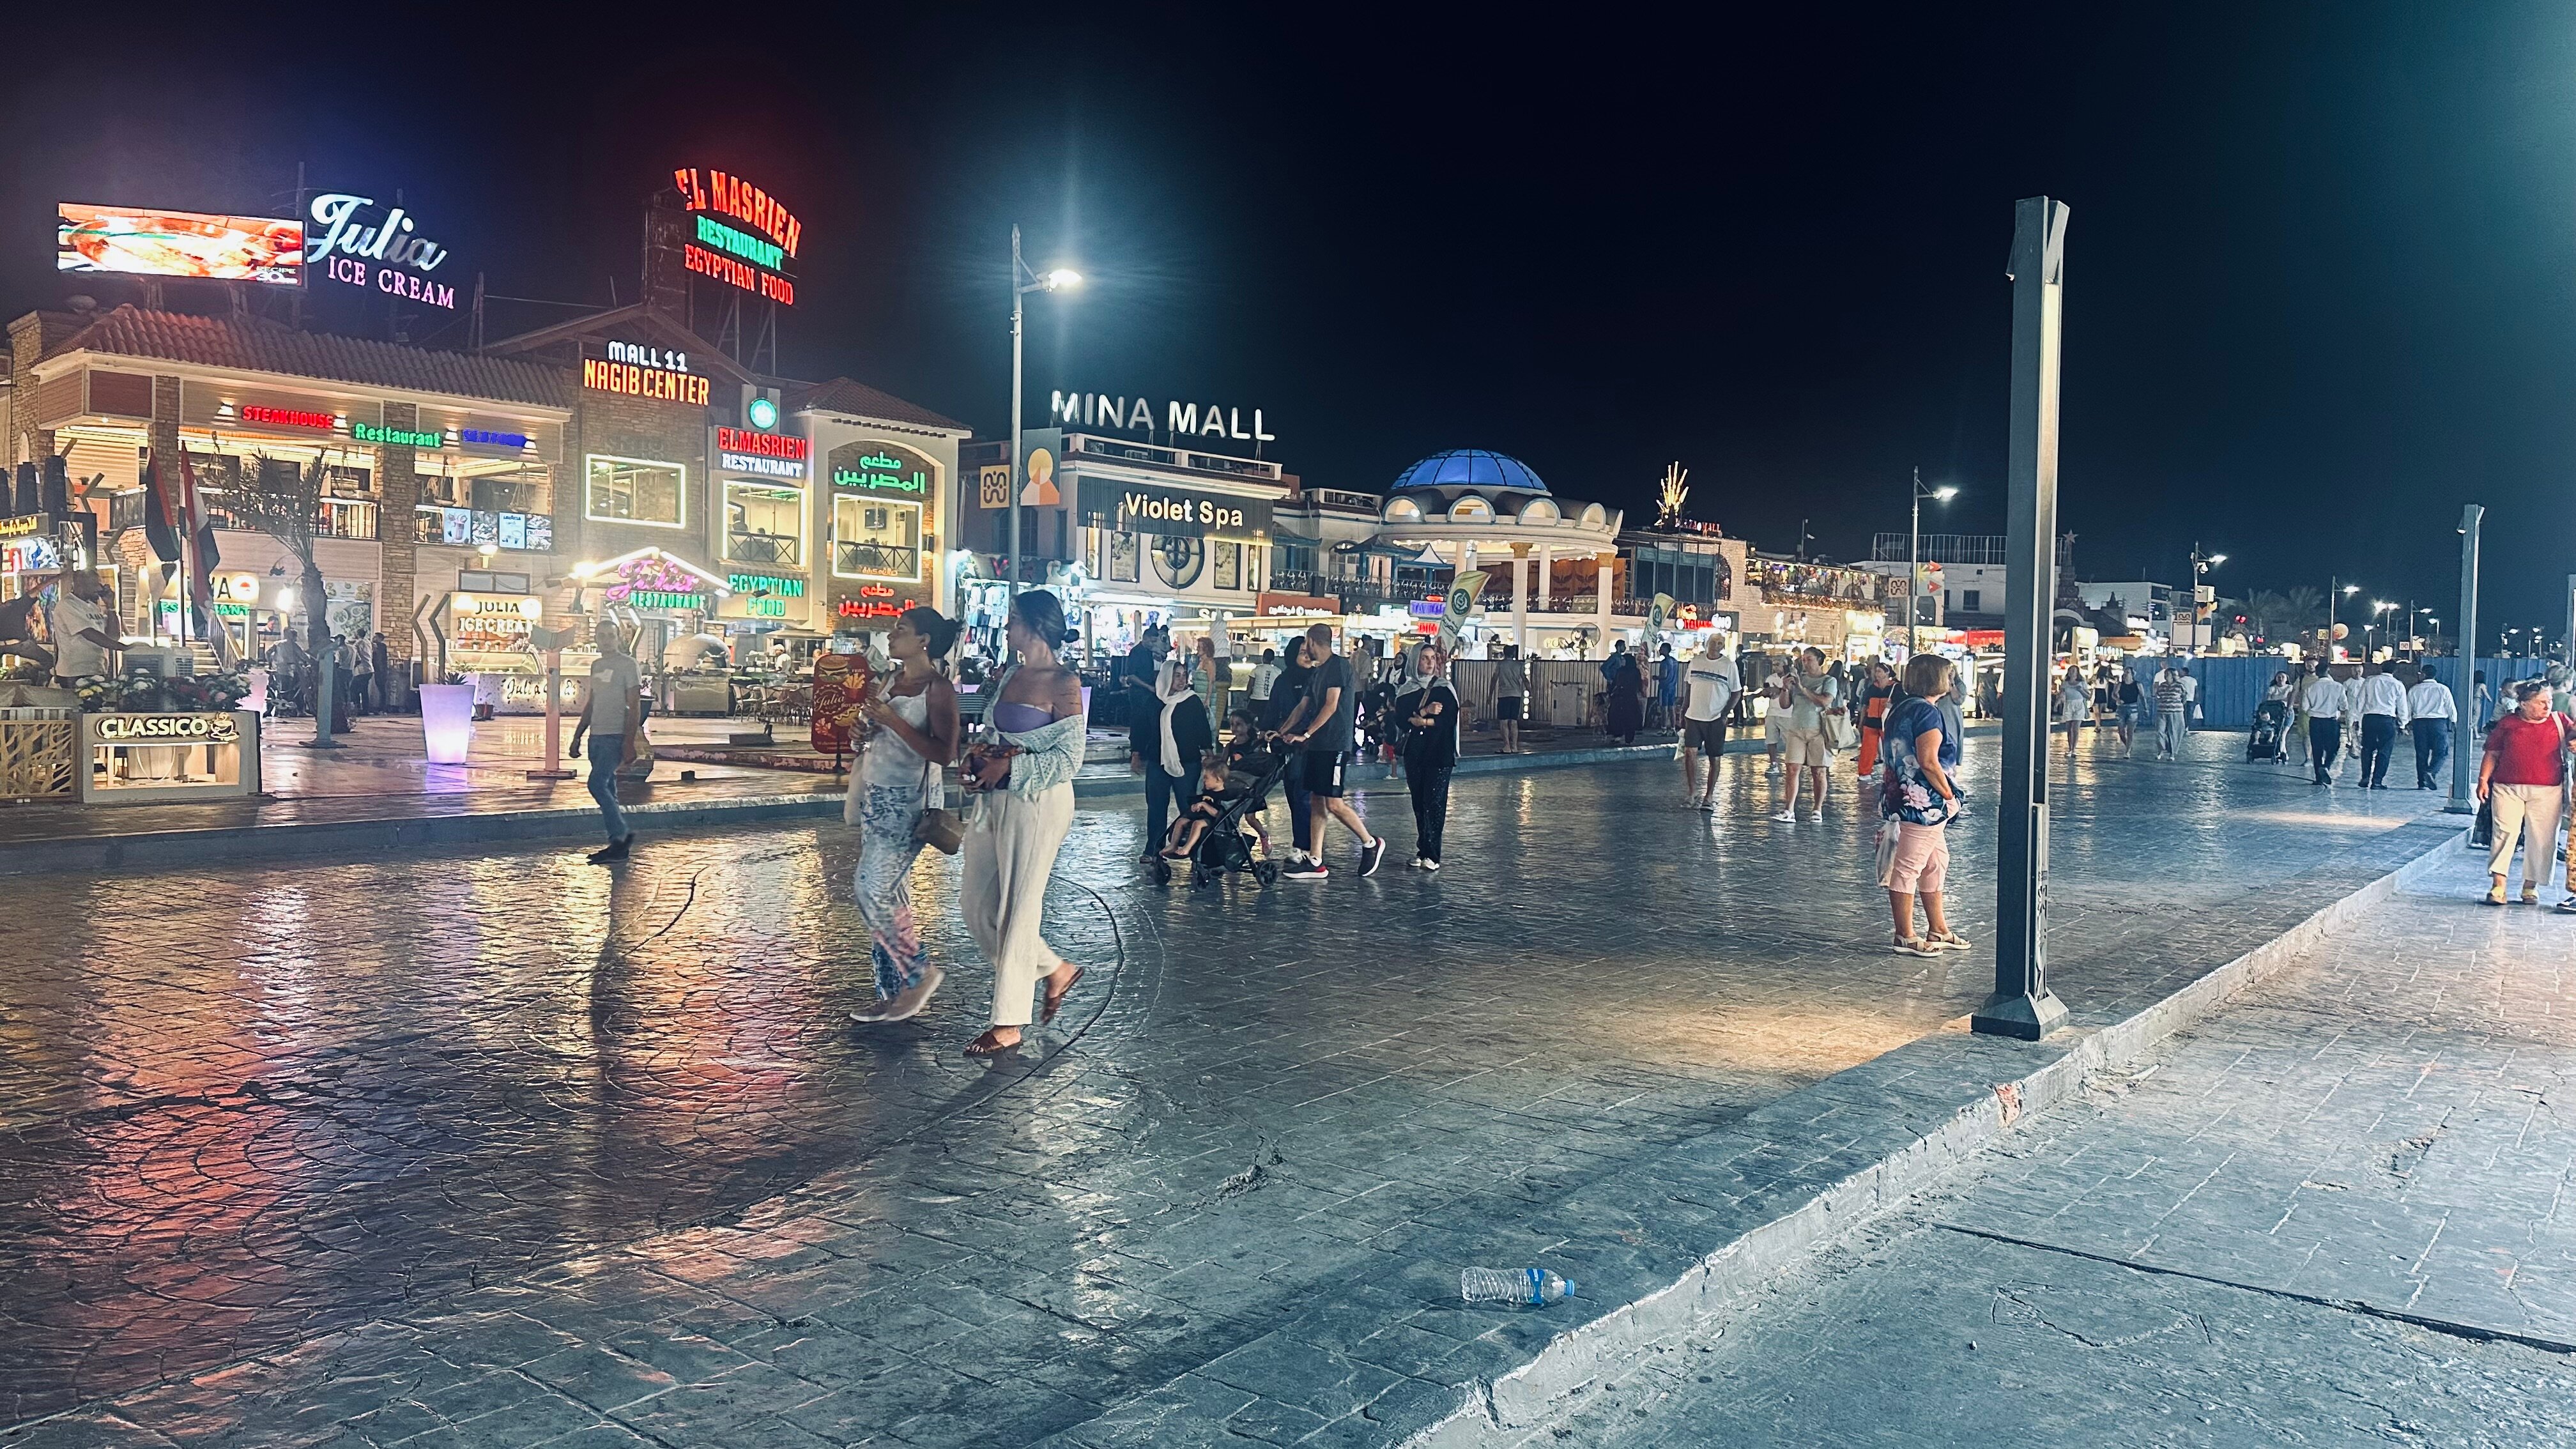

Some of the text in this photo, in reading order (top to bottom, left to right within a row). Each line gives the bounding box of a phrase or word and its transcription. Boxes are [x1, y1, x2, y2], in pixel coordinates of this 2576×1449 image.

[675, 169, 801, 257] EL MASRIEN
[307, 194, 447, 271] Julia
[697, 215, 783, 270] RESTAURANT
[328, 256, 454, 309] ICE CREAM
[684, 243, 793, 305] EGYPTIAN FOOD
[608, 341, 687, 372] MALL 11
[584, 358, 709, 406] NAGIB CENTER
[243, 406, 334, 429] STEAKHOUSE
[1052, 390, 1275, 441] MINA MALL
[355, 423, 441, 447] Restaurant
[722, 453, 803, 477] RESTAURANT
[860, 451, 901, 469] مطعم
[834, 466, 925, 494] المصريين
[1125, 491, 1243, 530] Violet Spa
[728, 574, 802, 597] EGYPTIAN
[861, 582, 894, 597] مطعم
[475, 601, 519, 615] JULIA
[630, 592, 705, 608] RESTAURANT
[746, 598, 785, 617] FOOD
[814, 694, 845, 712] Julia
[101, 718, 208, 739] CLASSICO
